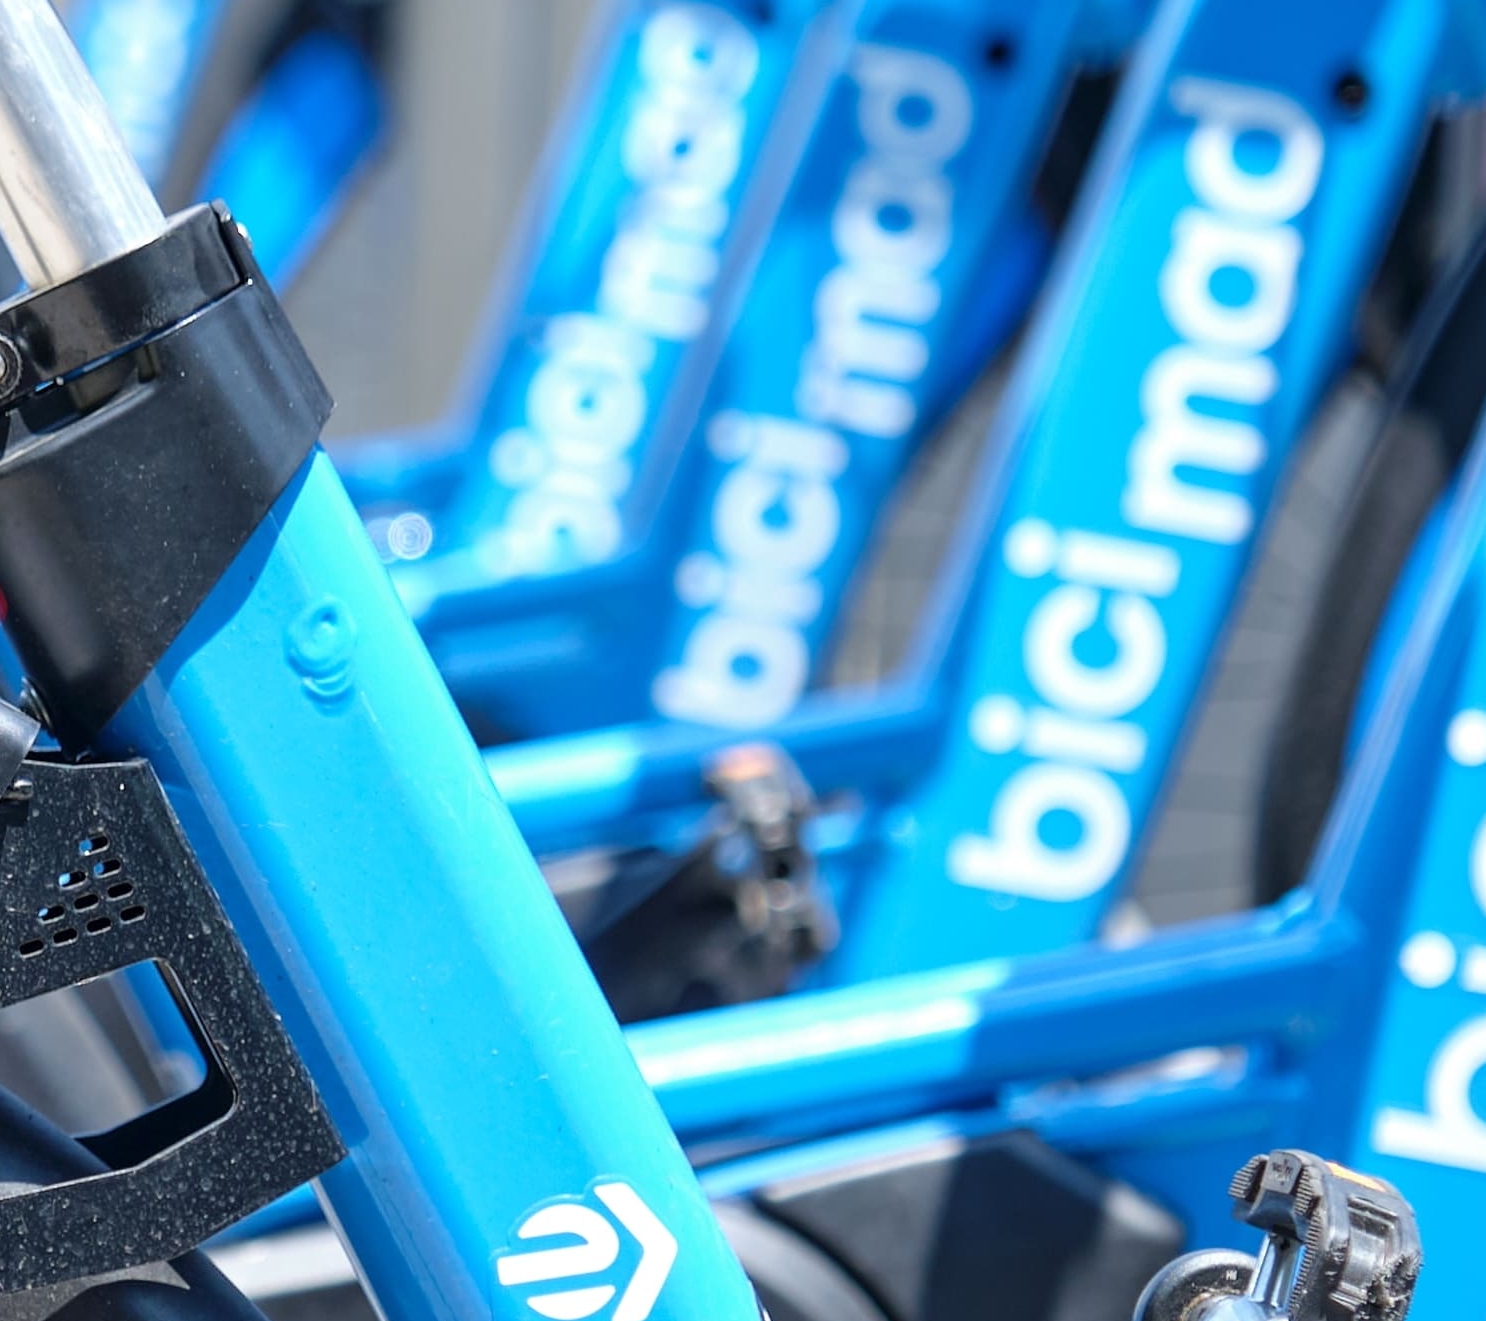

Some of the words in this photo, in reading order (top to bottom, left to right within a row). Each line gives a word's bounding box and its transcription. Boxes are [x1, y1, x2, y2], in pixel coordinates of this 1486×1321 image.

[651, 409, 848, 728] bici
[796, 43, 973, 438] mad
[946, 517, 1180, 902] bici
[1121, 75, 1324, 544] mad
